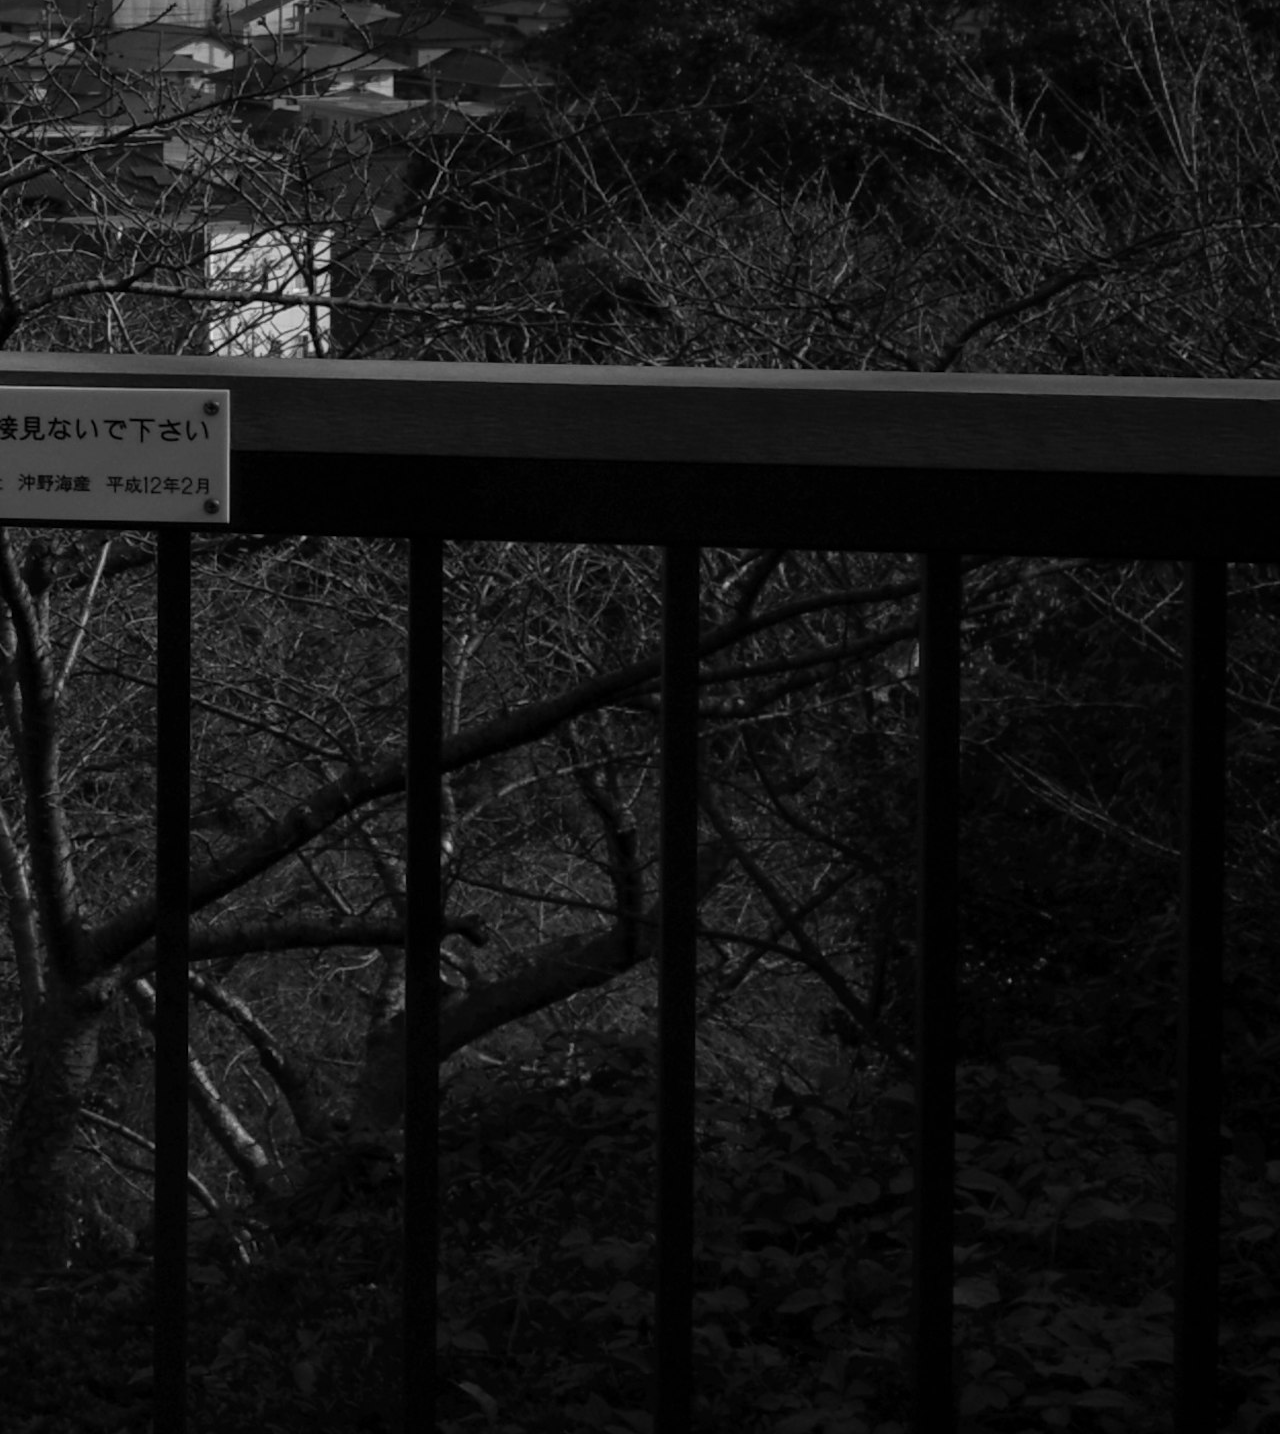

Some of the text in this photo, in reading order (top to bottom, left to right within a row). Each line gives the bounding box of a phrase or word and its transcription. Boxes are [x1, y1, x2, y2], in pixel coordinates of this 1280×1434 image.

[18, 473, 91, 493] 沖野海産
[106, 476, 211, 495] 平成12年2月
